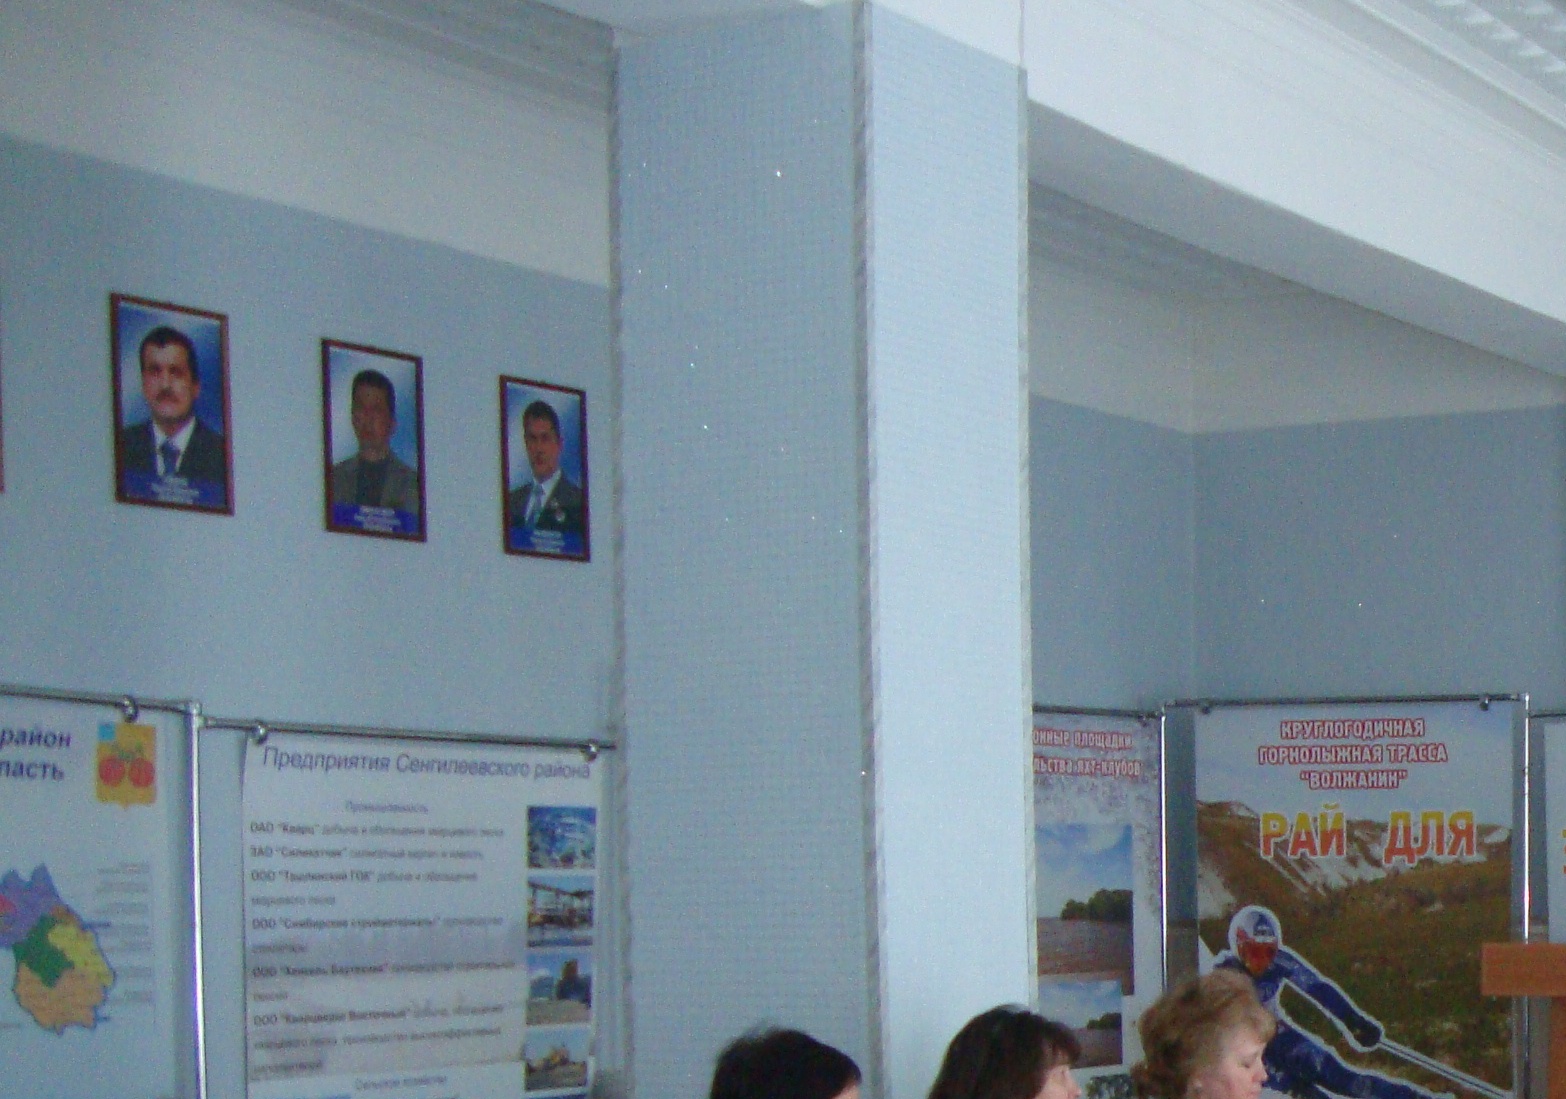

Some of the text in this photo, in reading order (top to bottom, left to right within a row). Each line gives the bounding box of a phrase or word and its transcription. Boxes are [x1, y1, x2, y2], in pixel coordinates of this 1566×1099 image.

[0, 723, 72, 749] район
[1280, 718, 1426, 740] КРУГЛОГОДИЧНАЯ
[263, 745, 591, 779] Предприятия Сенгилеевского района
[1258, 743, 1448, 765] ГОРНОЛЫЖНАЯ ТРАССА
[1300, 769, 1408, 790] "ВОЛЖАНИН"
[1260, 803, 1346, 858] РАЙ
[1383, 810, 1477, 865] ДЛЯ
